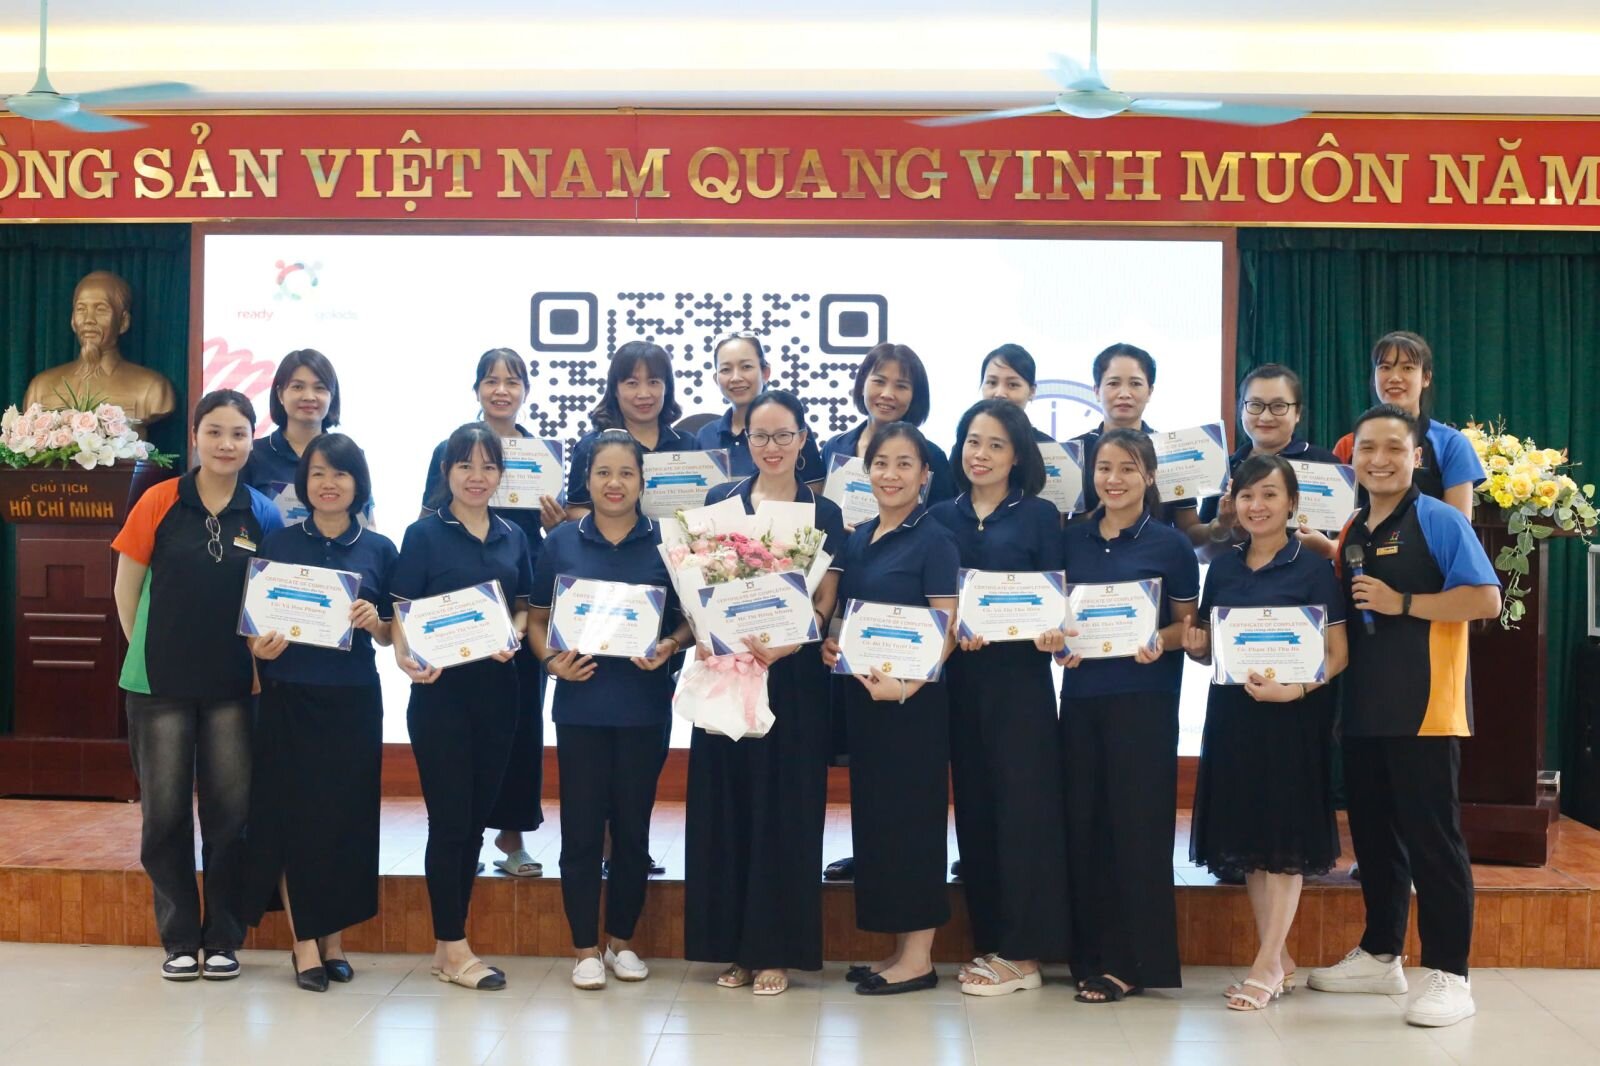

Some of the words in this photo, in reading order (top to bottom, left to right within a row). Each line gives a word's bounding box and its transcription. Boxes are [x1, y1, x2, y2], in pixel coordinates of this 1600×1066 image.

[134, 122, 283, 200] SẢN
[301, 129, 481, 211] VIỆT
[497, 147, 670, 198] NAM
[687, 146, 948, 204] QUANG
[960, 149, 1162, 200] VINH
[1181, 132, 1409, 203] MUÔN
[1428, 138, 1600, 206] NĂM
[237, 309, 273, 321] ready
[31, 480, 56, 493] CHỦ
[60, 483, 88, 496] TỊCH
[10, 495, 31, 518] HỒ
[37, 497, 64, 518] CHÍ
[70, 501, 114, 518] MINH
[265, 576, 298, 585] CERTIFICATE
[307, 582, 343, 592] COMPLETION
[758, 586, 792, 596] COMPLETION
